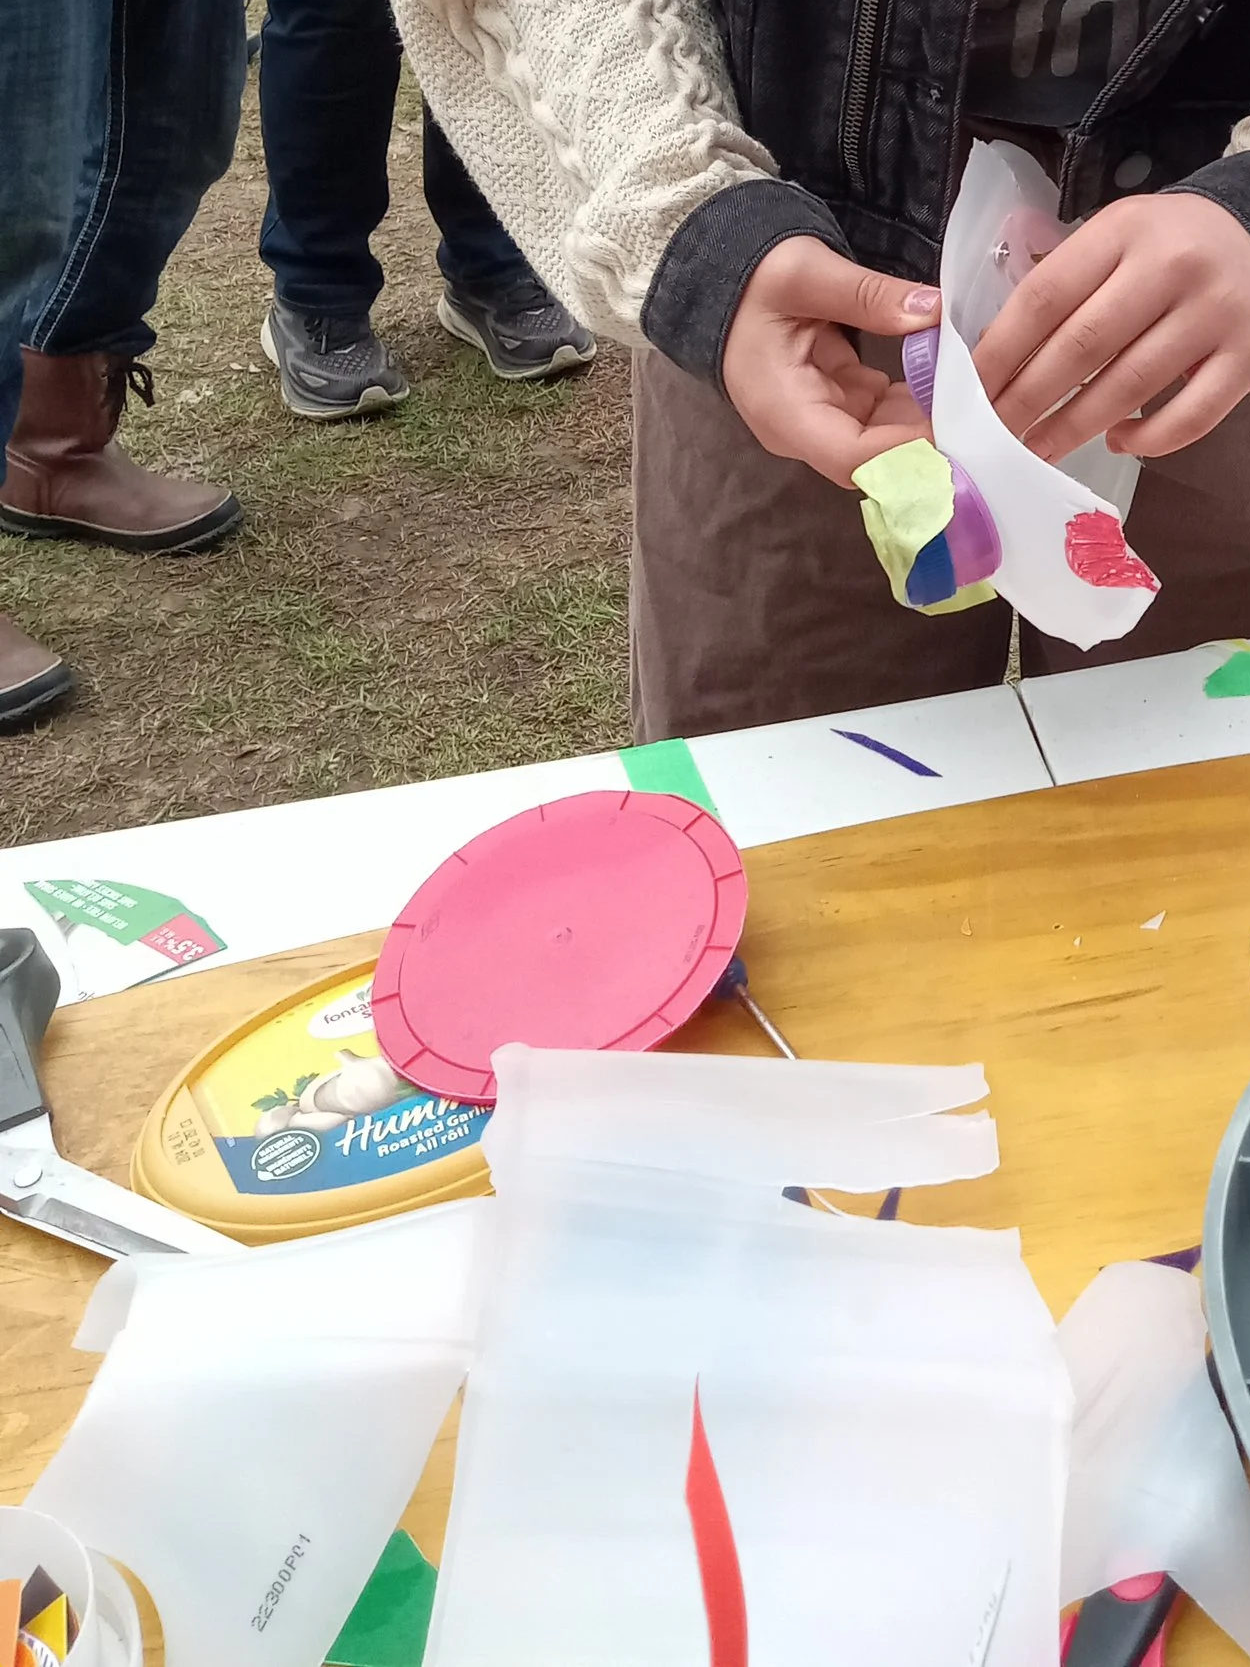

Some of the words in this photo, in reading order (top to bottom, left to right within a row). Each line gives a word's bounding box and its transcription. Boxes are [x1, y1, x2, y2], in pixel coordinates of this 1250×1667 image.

[323, 1001, 371, 1024] fonta
[377, 1120, 445, 1158] Roasted
[415, 1136, 438, 1156] All
